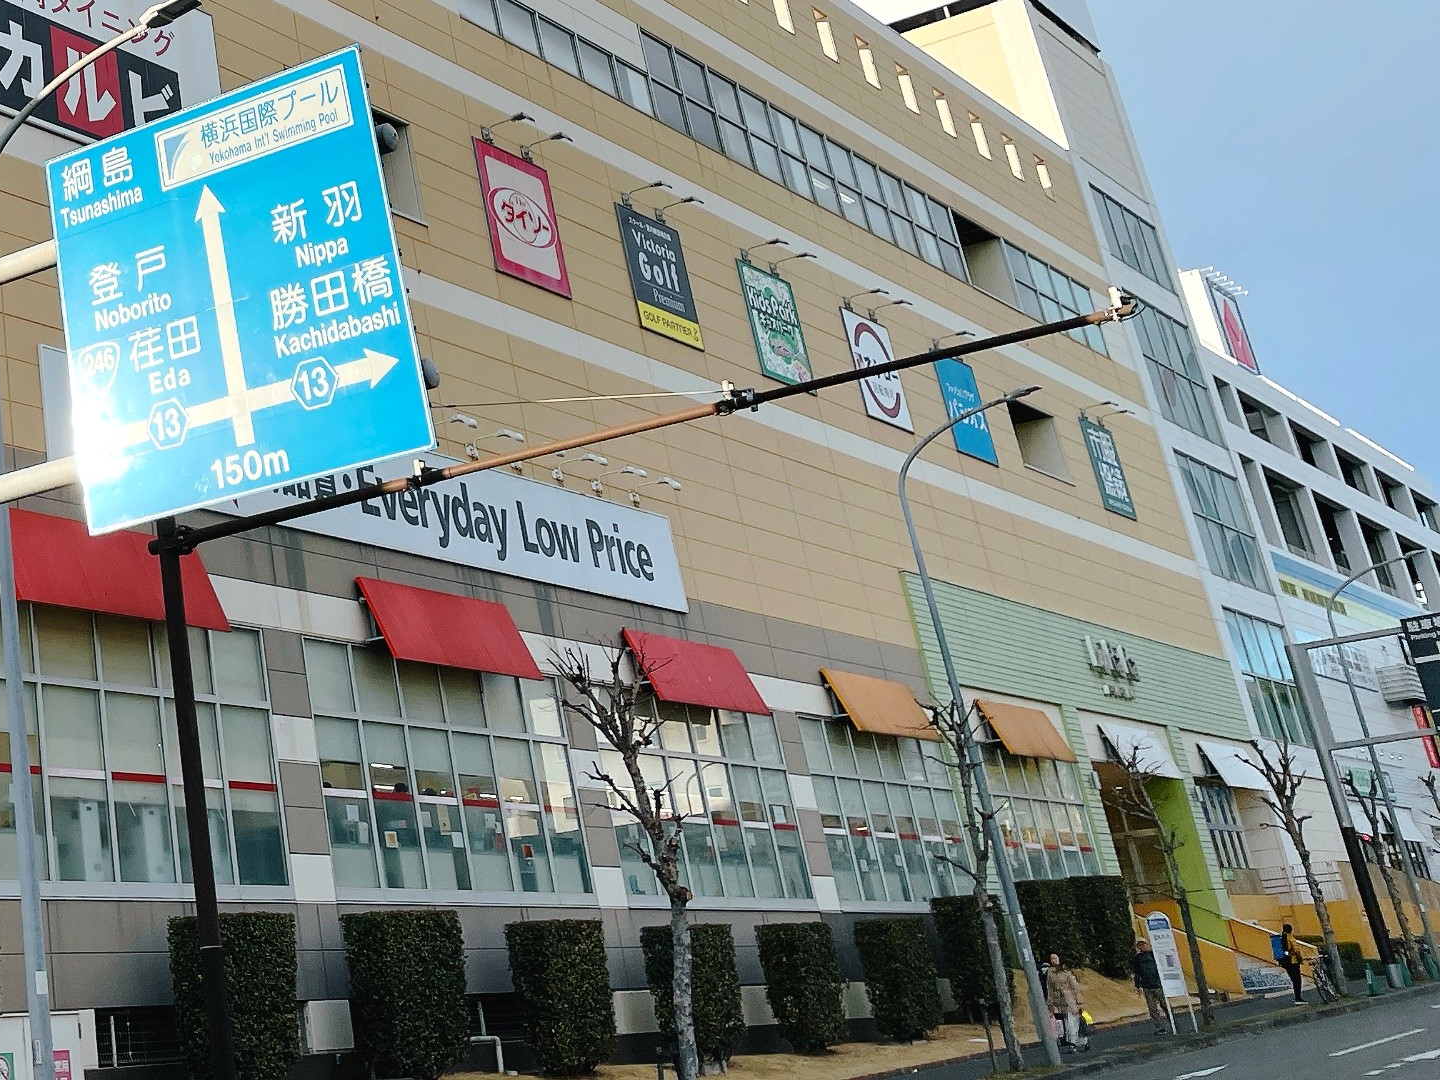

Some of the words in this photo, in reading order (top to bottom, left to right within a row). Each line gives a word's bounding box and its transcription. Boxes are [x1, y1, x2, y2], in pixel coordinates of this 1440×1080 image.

[200, 80, 339, 149] 横浜国際プール
[209, 139, 252, 165] Yokohama
[254, 131, 271, 150] Int'l
[272, 117, 317, 144] Swimming
[318, 108, 339, 127] Pool
[61, 146, 133, 203] 綱島
[60, 185, 144, 230] Tsunashima
[271, 181, 364, 245] 新羽
[501, 200, 550, 233] ダイソー
[295, 238, 350, 269] Nippa
[631, 228, 677, 263] Victoria
[88, 245, 168, 307] 登戸
[269, 255, 394, 332] 勝田橋
[638, 251, 681, 294] Golf
[94, 292, 173, 332] Noborito
[273, 301, 403, 359] Kachidabashi
[643, 310, 661, 325] GOLF
[80, 347, 116, 378] 246
[128, 316, 203, 372] 荏田
[148, 366, 192, 395] Eda
[298, 365, 330, 401] 13
[152, 407, 181, 441] 13
[211, 448, 291, 491] 150m
[516, 500, 580, 563] Low
[586, 519, 655, 582] Price
